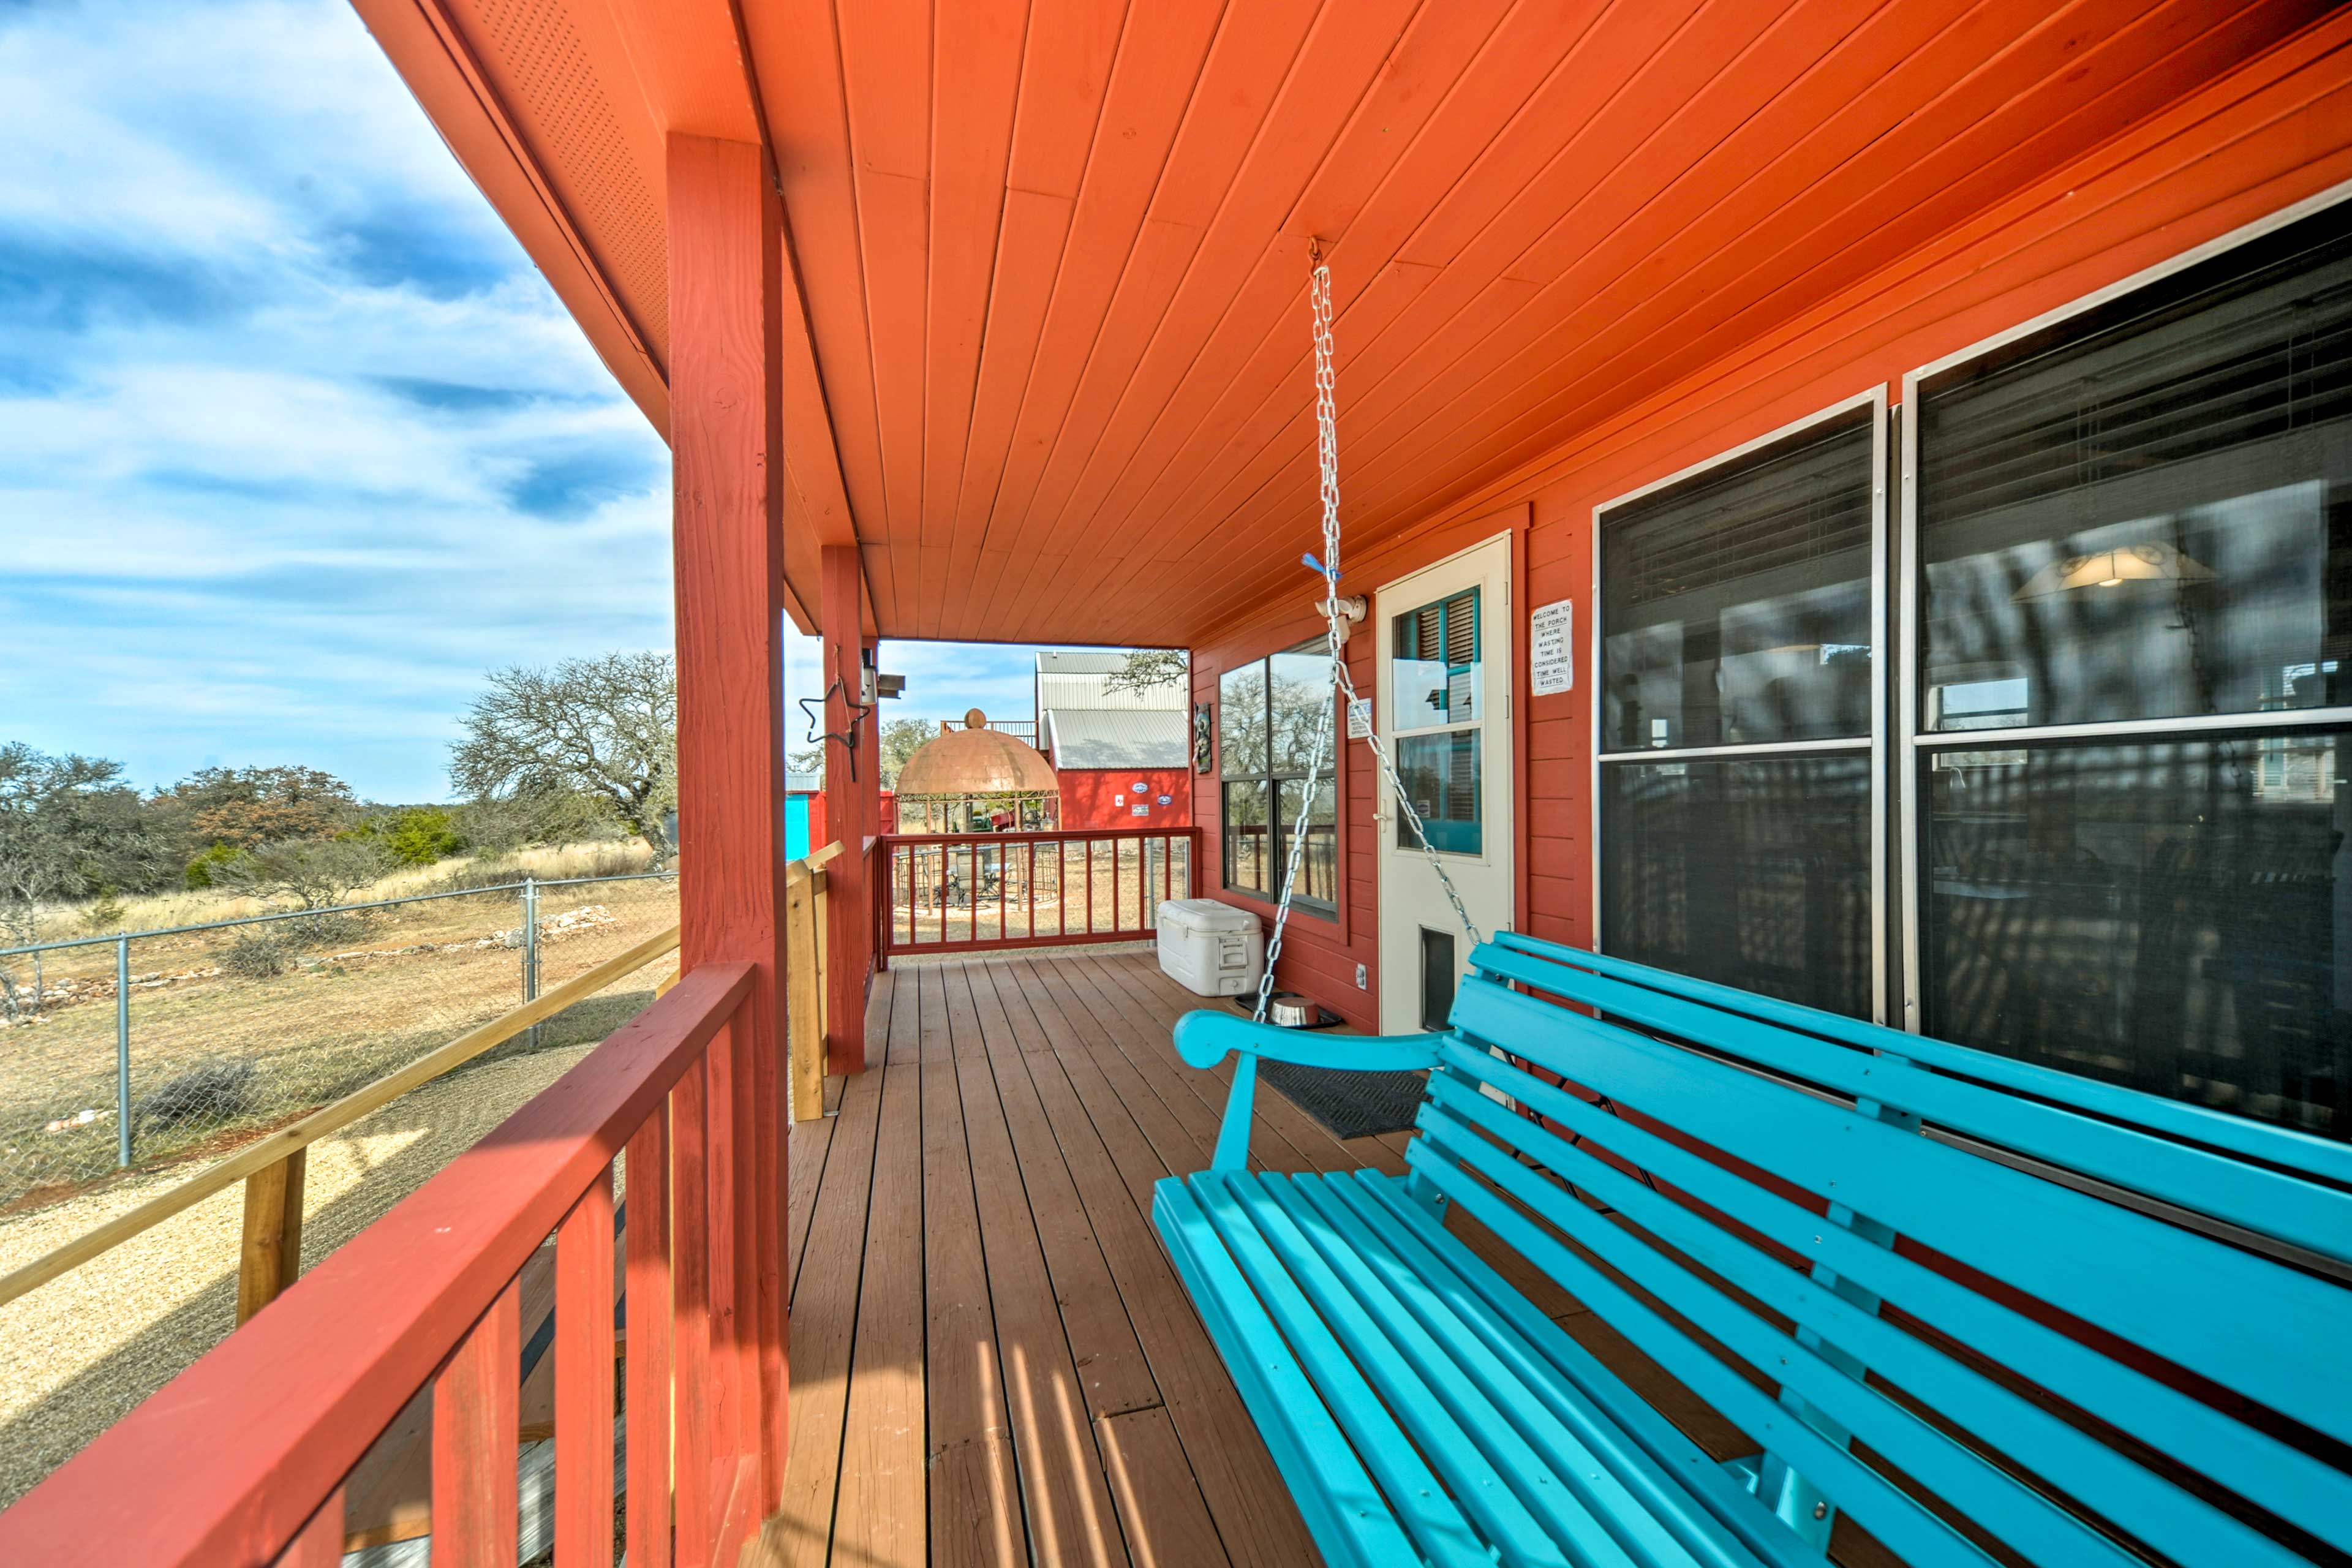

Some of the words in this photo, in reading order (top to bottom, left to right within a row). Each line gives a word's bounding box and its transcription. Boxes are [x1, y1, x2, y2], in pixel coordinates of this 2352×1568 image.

[1533, 609, 1558, 620] WELCOME
[1548, 617, 1567, 626] PORCH
[1541, 628, 1561, 637] WHERE
[1539, 637, 1564, 647] WASTING
[1534, 656, 1568, 668] CONSIDERED
[1540, 677, 1563, 686] WASTED
